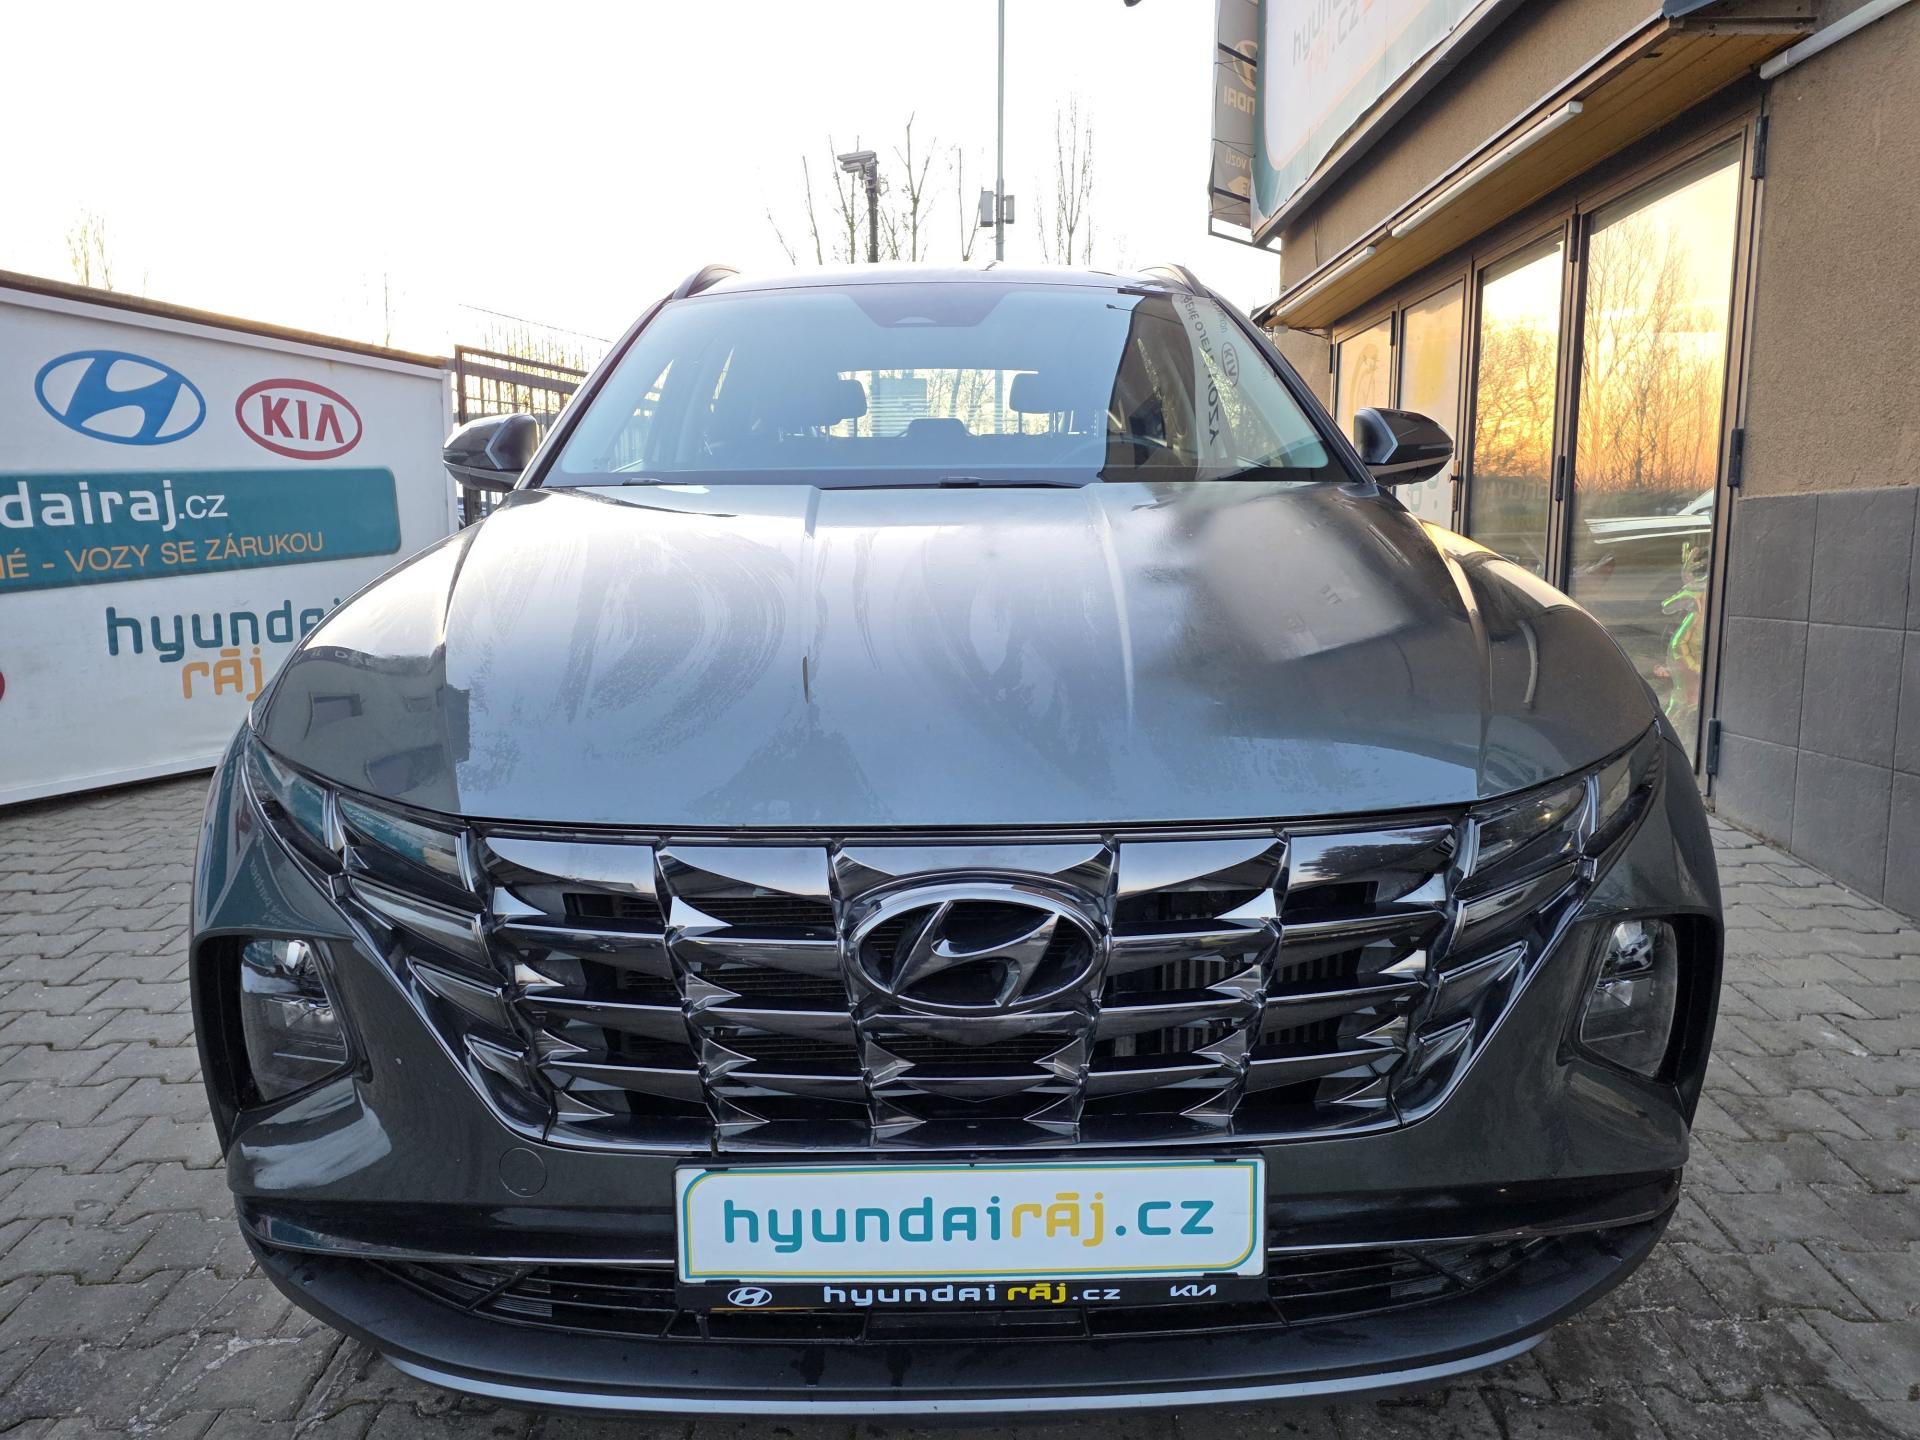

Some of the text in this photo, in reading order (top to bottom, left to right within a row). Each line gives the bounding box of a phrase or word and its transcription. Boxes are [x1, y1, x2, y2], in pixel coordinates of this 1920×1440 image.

[260, 394, 345, 444] KIA
[65, 543, 150, 573] VOZY
[161, 540, 198, 565] SE
[205, 531, 324, 562] ZÁRUKOU
[105, 597, 341, 663] hyunda
